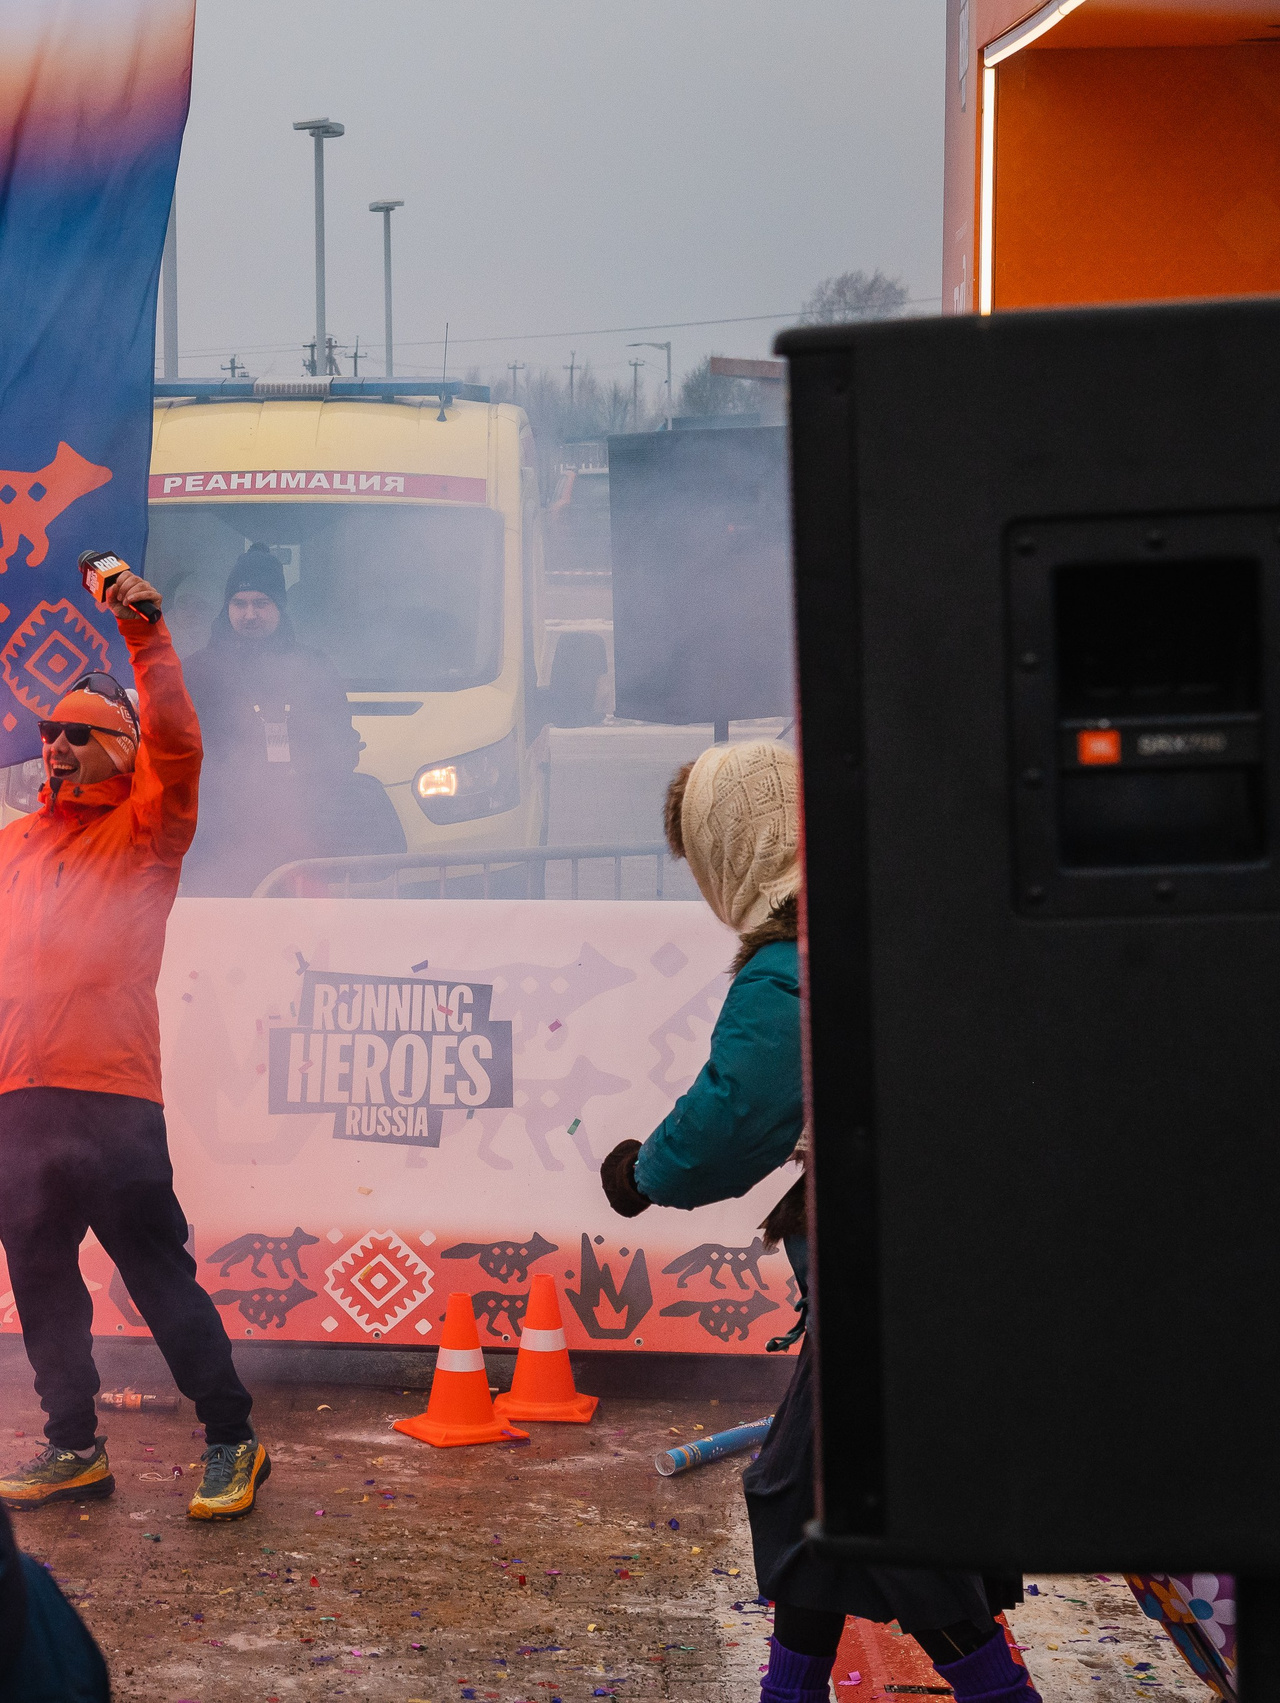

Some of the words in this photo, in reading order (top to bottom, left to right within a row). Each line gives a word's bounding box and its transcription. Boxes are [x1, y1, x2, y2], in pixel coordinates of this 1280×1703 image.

[163, 472, 405, 494] РЕАНИМАЦИЯ
[94, 556, 122, 572] RHR
[312, 983, 474, 1032] RUNNING
[287, 1033, 493, 1106] HEROES
[345, 1106, 428, 1136] RUSSIA
